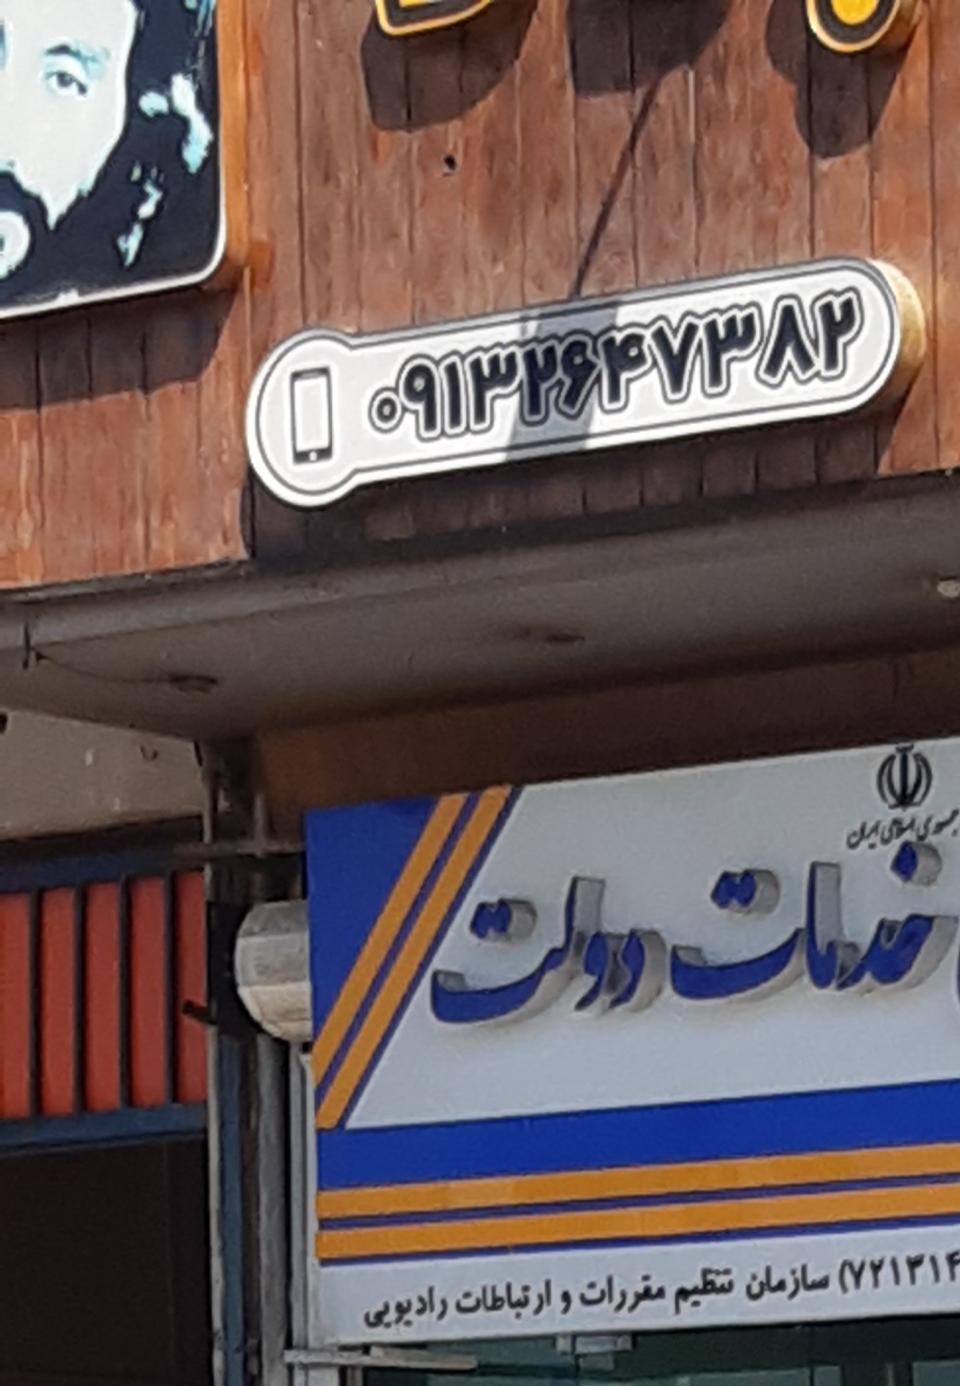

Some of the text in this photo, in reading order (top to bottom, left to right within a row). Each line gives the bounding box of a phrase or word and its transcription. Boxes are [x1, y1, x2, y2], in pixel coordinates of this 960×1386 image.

[370, 294, 859, 437] ۰۹۱۳۲۶۴۷۳۸۲
[847, 820, 880, 850] ایران
[669, 843, 959, 1002] خدمات
[430, 876, 666, 1024] دولت
[455, 1280, 552, 1319] ارتباطات
[560, 1290, 571, 1314] و
[579, 1276, 666, 1311] مقررات
[675, 1268, 734, 1314] تنظیم
[746, 1265, 830, 1301] سازمان
[364, 1286, 448, 1328] رادیویی
